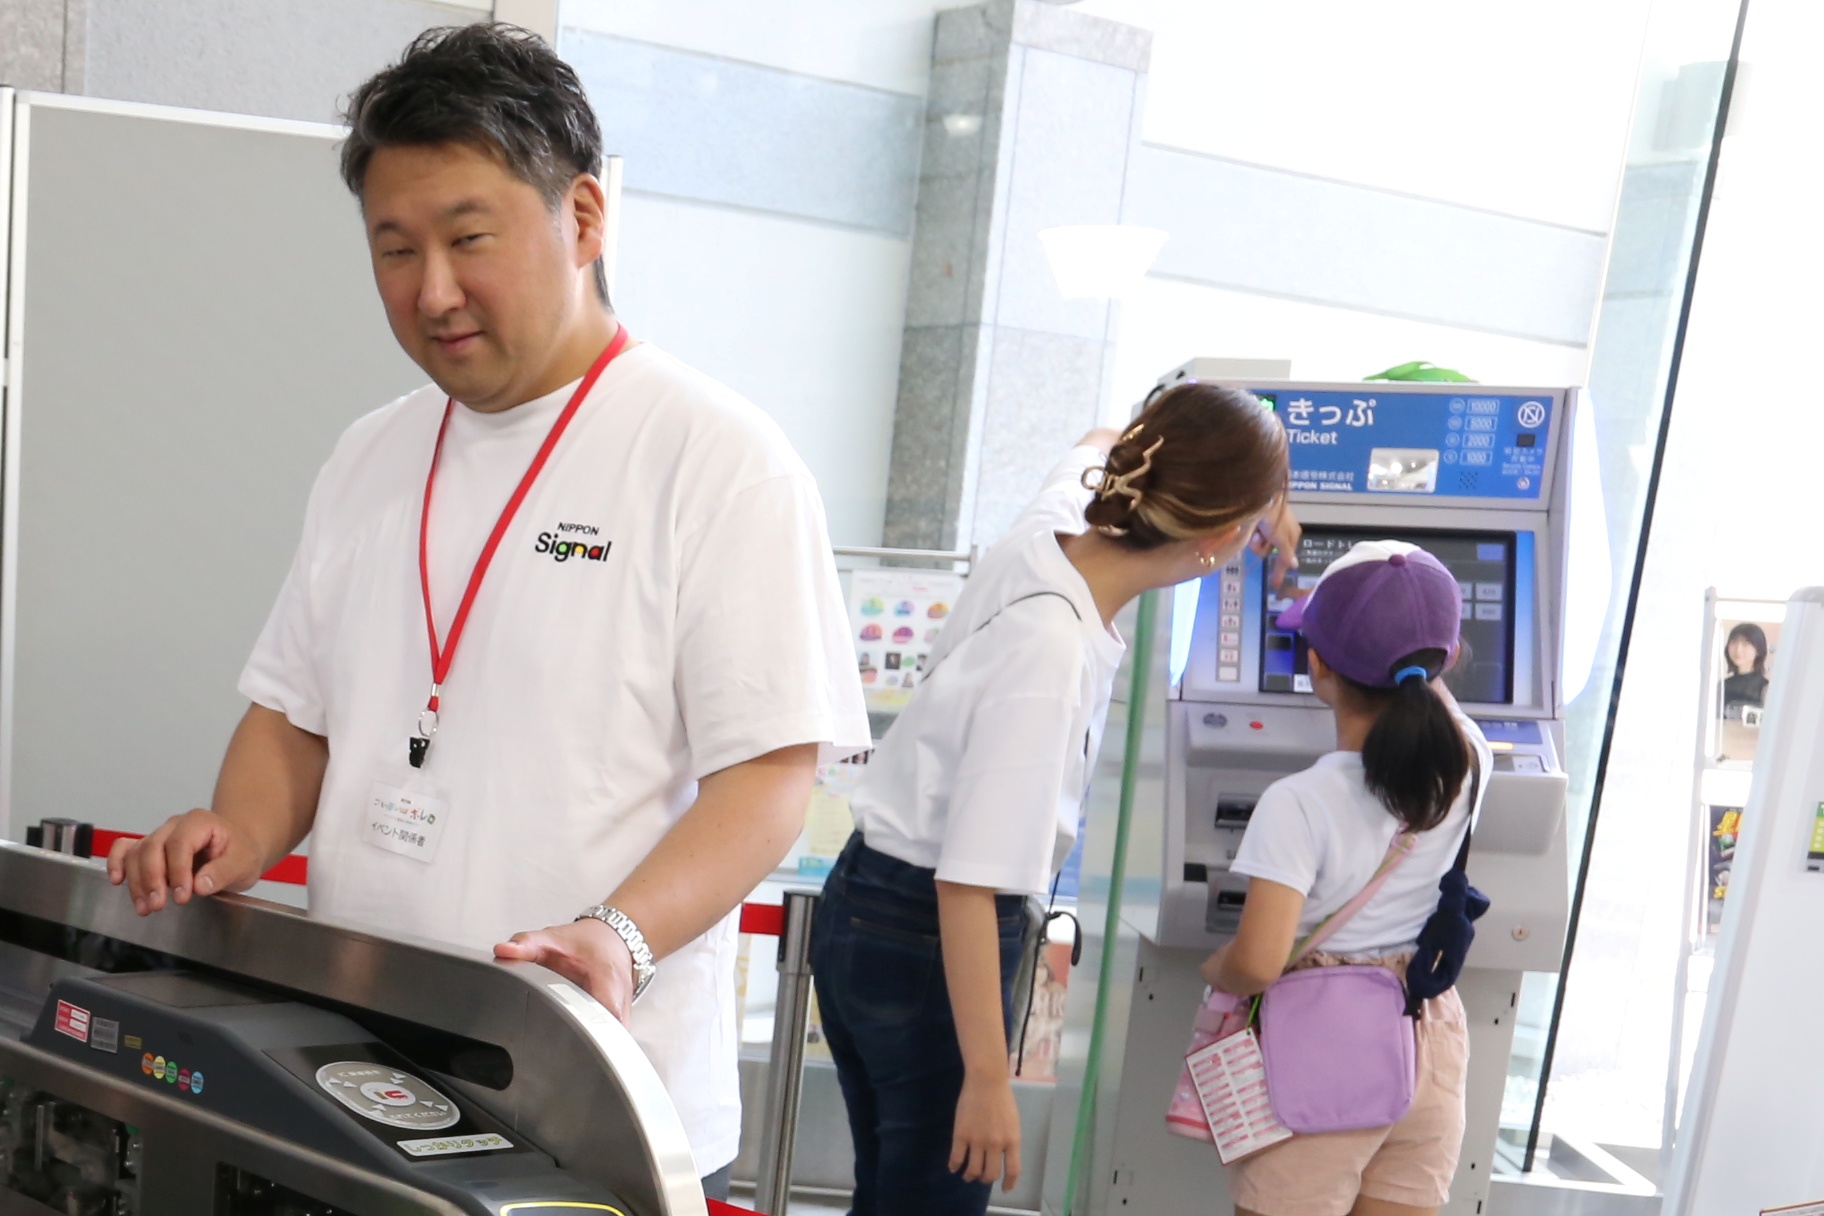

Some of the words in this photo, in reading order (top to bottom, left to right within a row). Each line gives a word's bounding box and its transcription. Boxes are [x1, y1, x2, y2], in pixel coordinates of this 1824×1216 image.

[1287, 398, 1377, 427] きっぷ
[1287, 428, 1339, 445] Ticket
[557, 521, 600, 536] NIPPON
[534, 531, 613, 563] Signal
